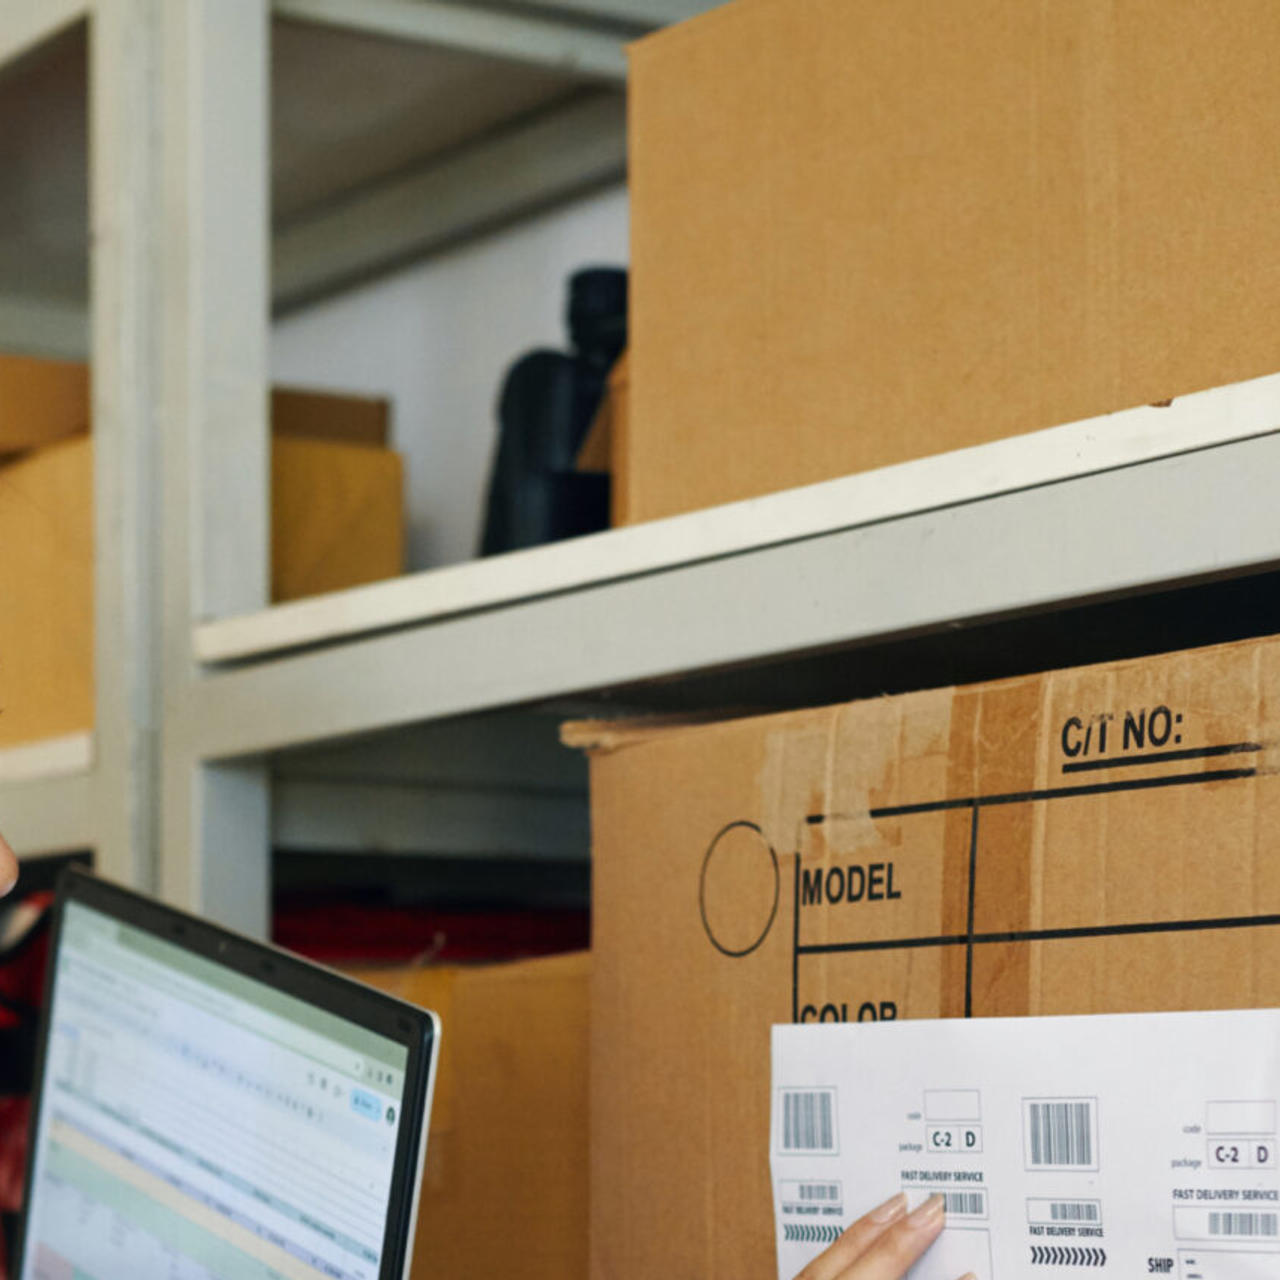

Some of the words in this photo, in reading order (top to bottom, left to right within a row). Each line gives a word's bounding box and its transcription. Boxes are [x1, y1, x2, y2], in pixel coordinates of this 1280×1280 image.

[1123, 706, 1183, 751] NO:
[801, 862, 902, 906] MODEL
[932, 1130, 952, 1147] C-2
[965, 1130, 977, 1148] D
[1215, 1145, 1240, 1163] C-2
[1256, 1145, 1269, 1164] D
[900, 1170, 918, 1181] FAST
[919, 1171, 952, 1182] DELIVERY
[953, 1171, 984, 1182] SERVICE
[1172, 1189, 1194, 1200] FAST
[1196, 1189, 1239, 1200] DELIVERY
[1242, 1189, 1279, 1201] SERVICE
[1147, 1257, 1174, 1274] SHIP
